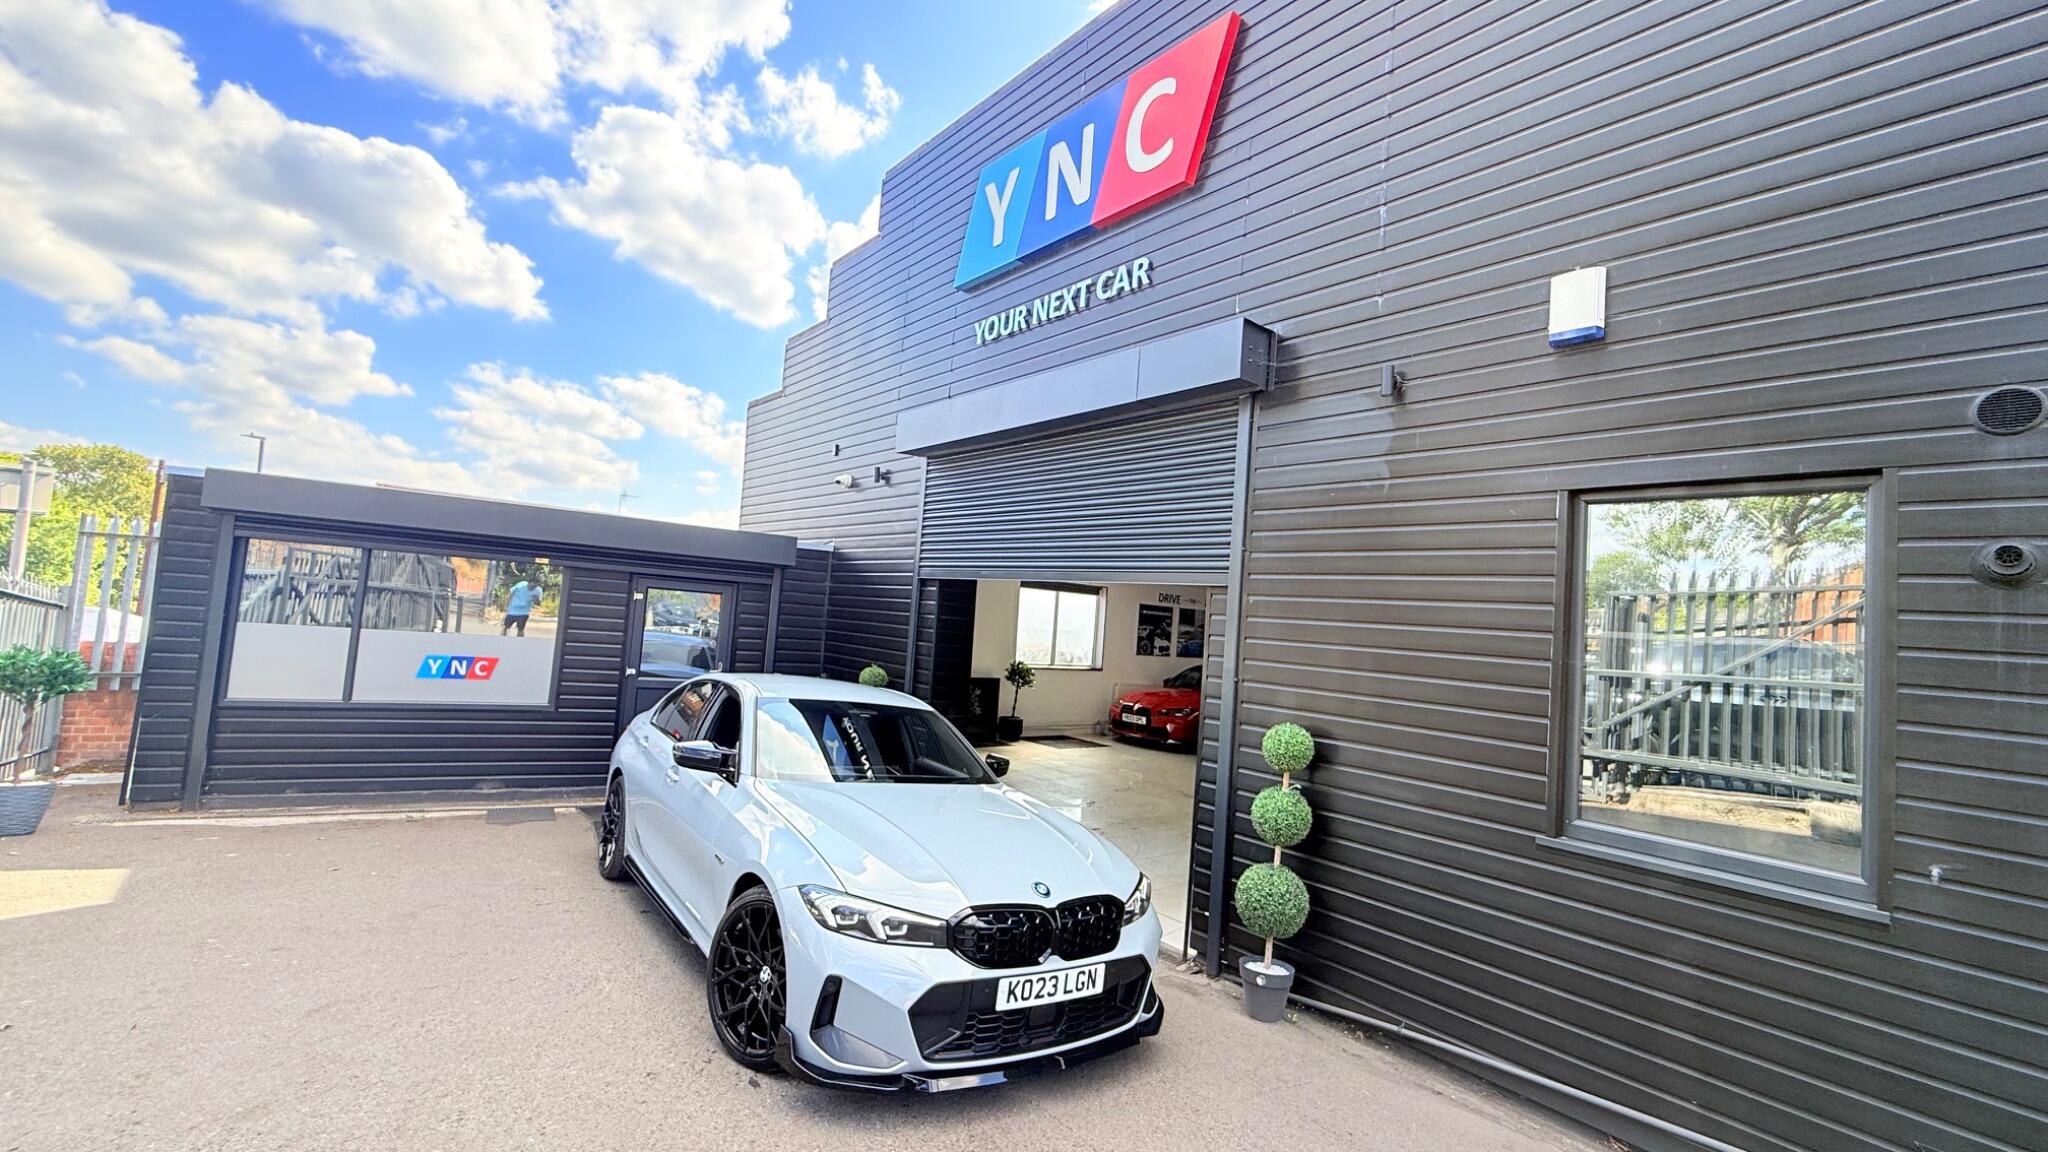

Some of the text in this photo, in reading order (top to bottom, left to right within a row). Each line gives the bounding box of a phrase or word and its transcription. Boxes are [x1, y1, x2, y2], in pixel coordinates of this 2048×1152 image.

[984, 77, 1177, 248] YNC
[974, 257, 1150, 346] YOUR NEXT CAR
[1158, 593, 1181, 604] DRIVE
[428, 659, 488, 676] YNC
[1006, 968, 1098, 1004] KO23 LGN
